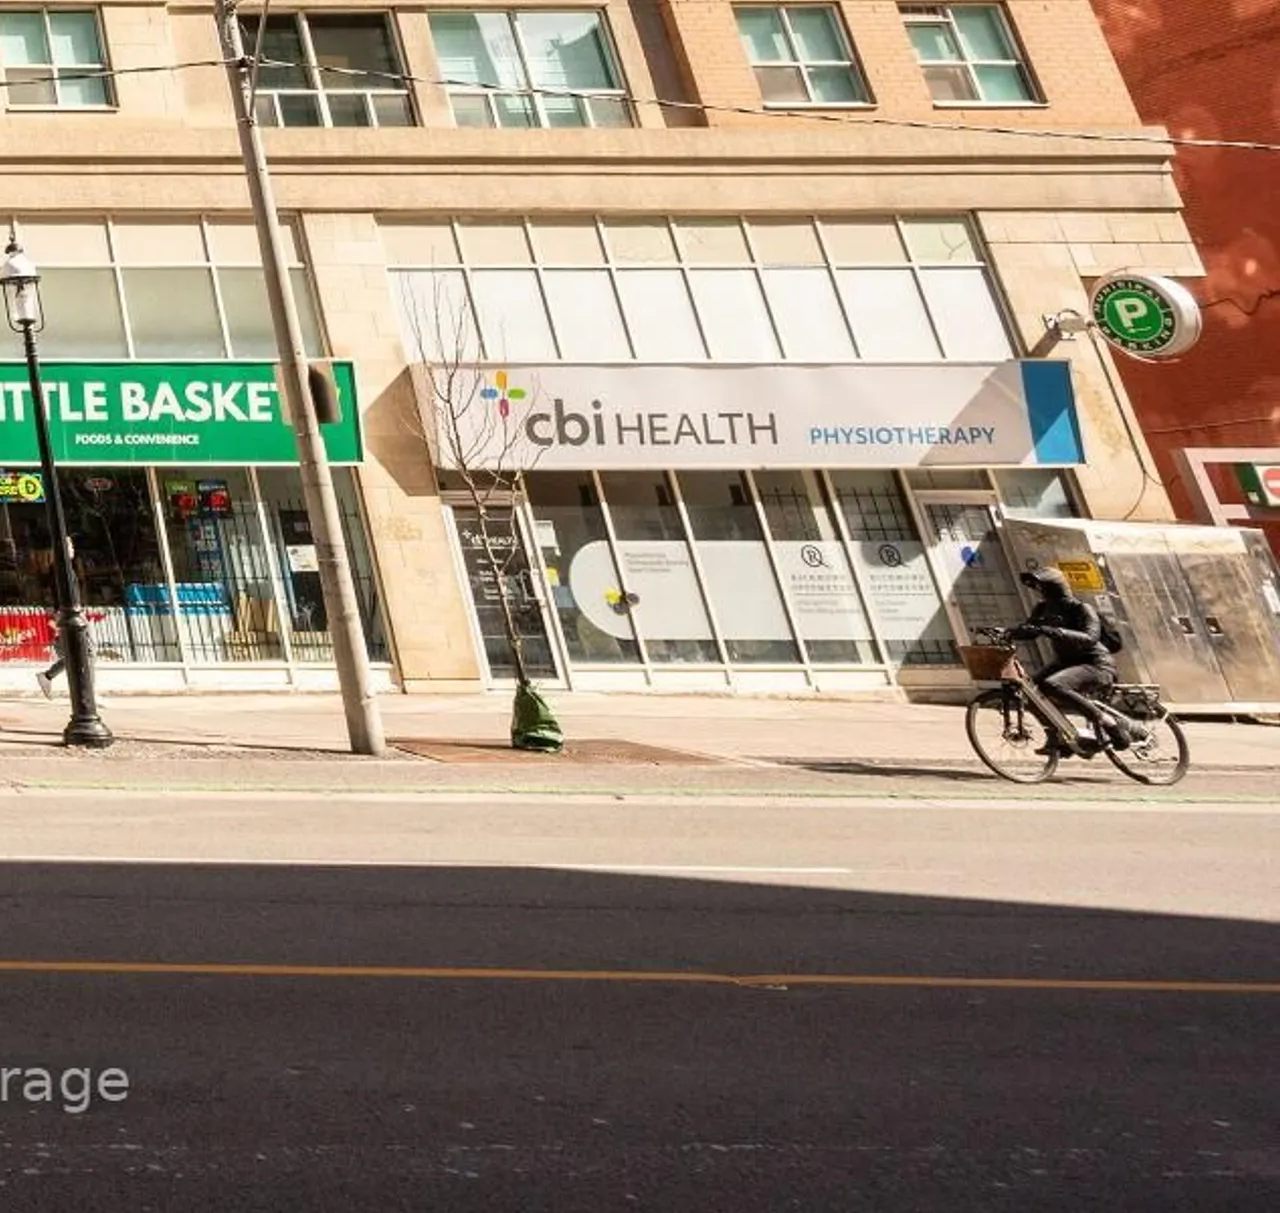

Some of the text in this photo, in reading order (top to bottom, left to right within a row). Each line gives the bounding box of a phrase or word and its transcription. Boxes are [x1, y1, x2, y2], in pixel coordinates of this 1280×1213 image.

[1114, 298, 1148, 330] P
[120, 381, 279, 423] BASKE
[526, 398, 779, 446] cbi HEALTH
[810, 426, 996, 445] PHYSIOTHERAPY
[75, 433, 200, 445] FOODS & CONVENIENCE
